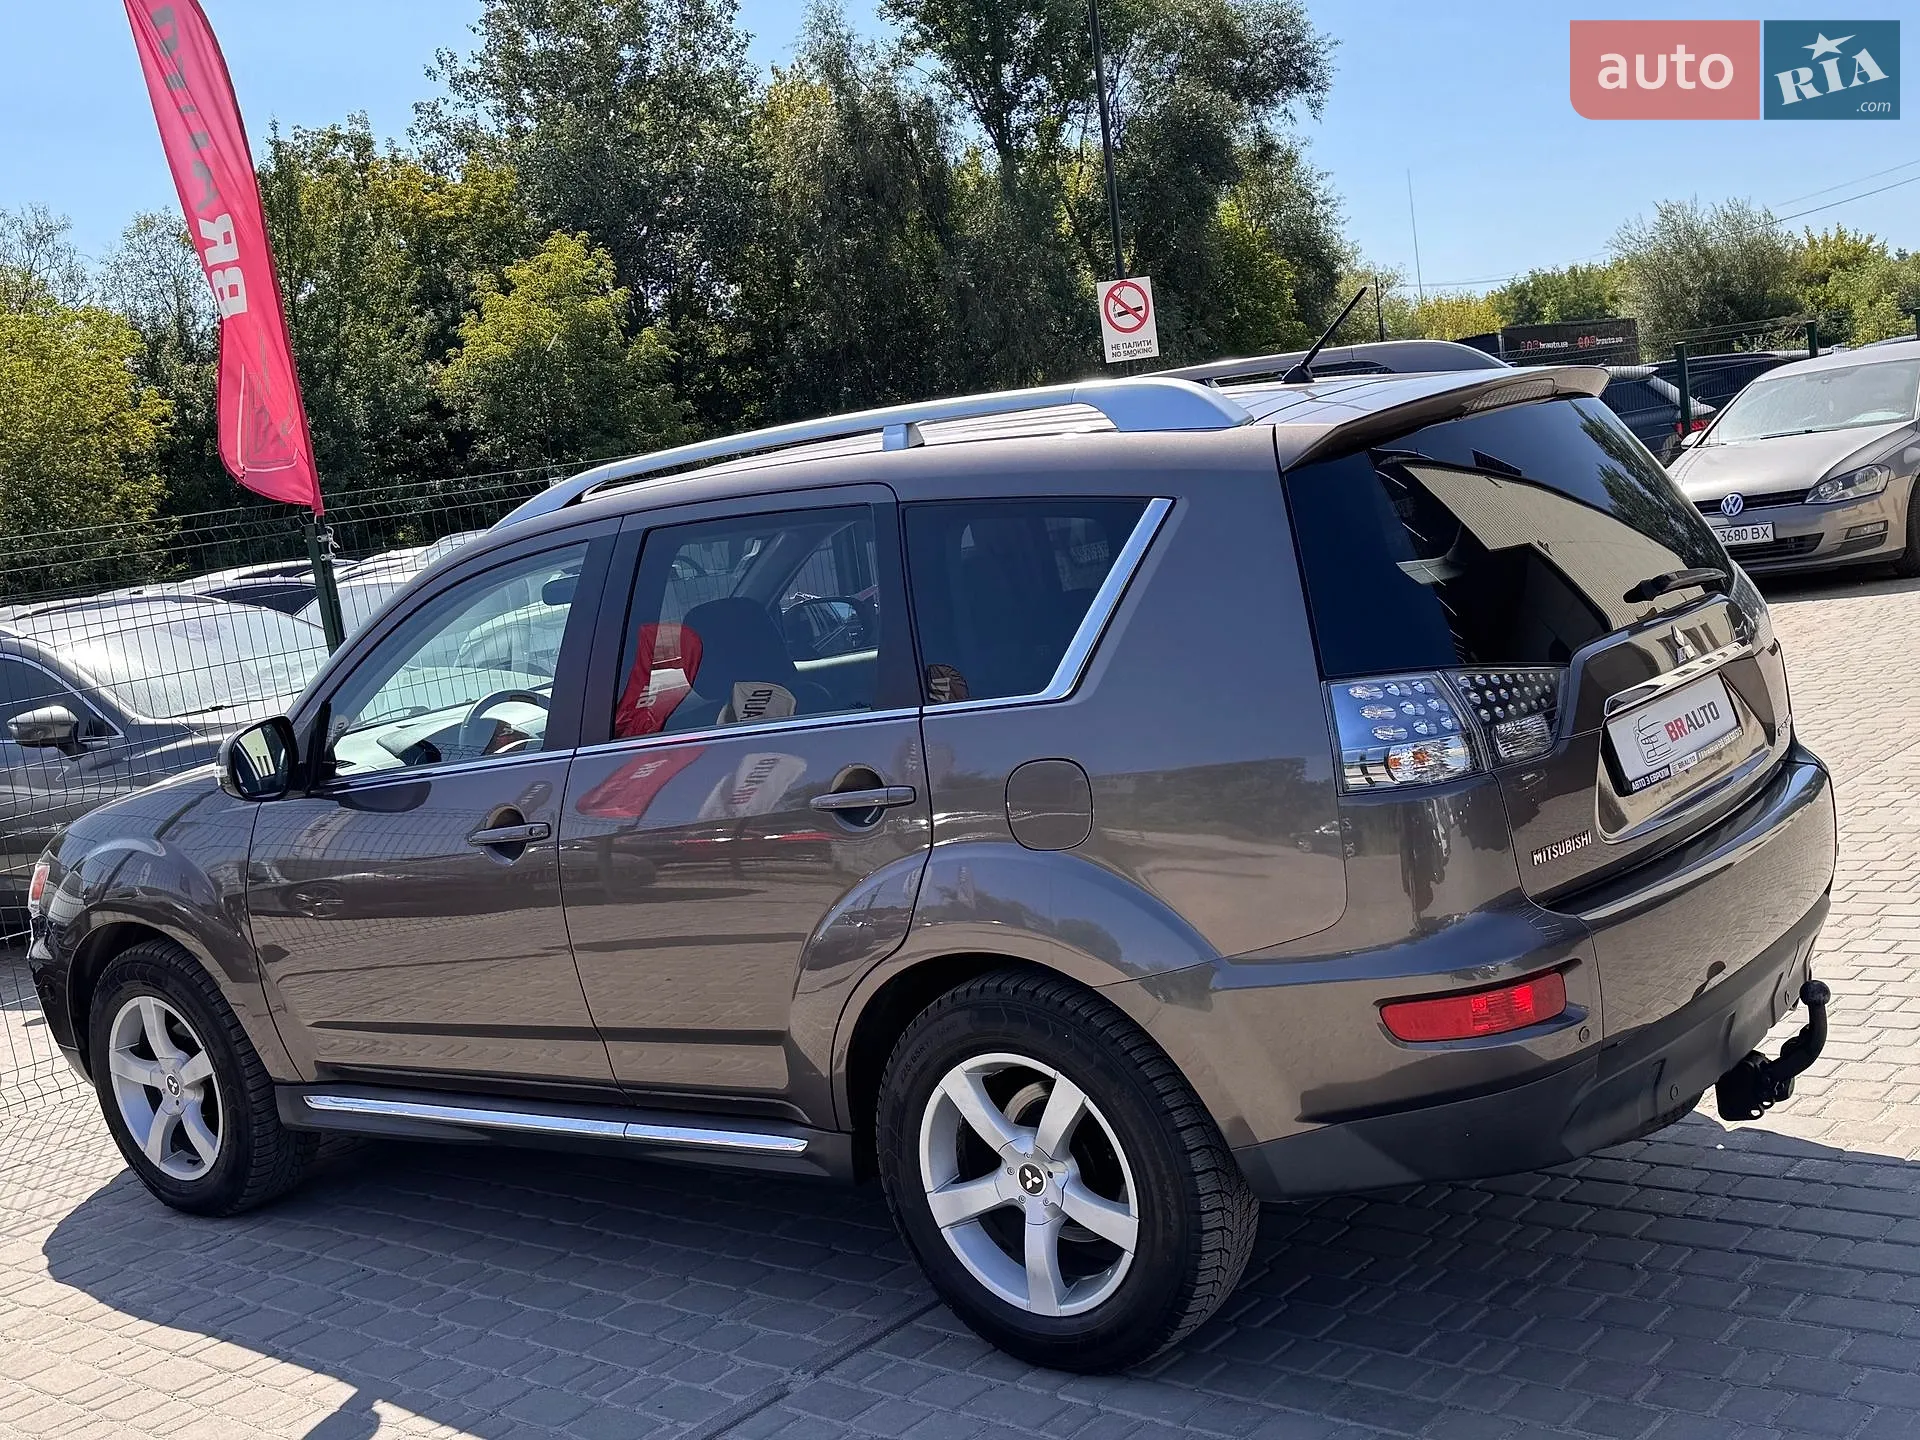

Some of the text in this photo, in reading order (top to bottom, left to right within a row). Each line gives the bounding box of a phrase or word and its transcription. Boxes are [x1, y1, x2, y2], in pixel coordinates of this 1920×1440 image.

[1111, 339, 1152, 351] НЕ ПАЛИТИ
[1122, 347, 1153, 357] SMOKING
[1720, 526, 1770, 543] 3680 BX
[1664, 701, 1720, 742] BRAUTO
[1531, 829, 1592, 866] MITSUBISHI
